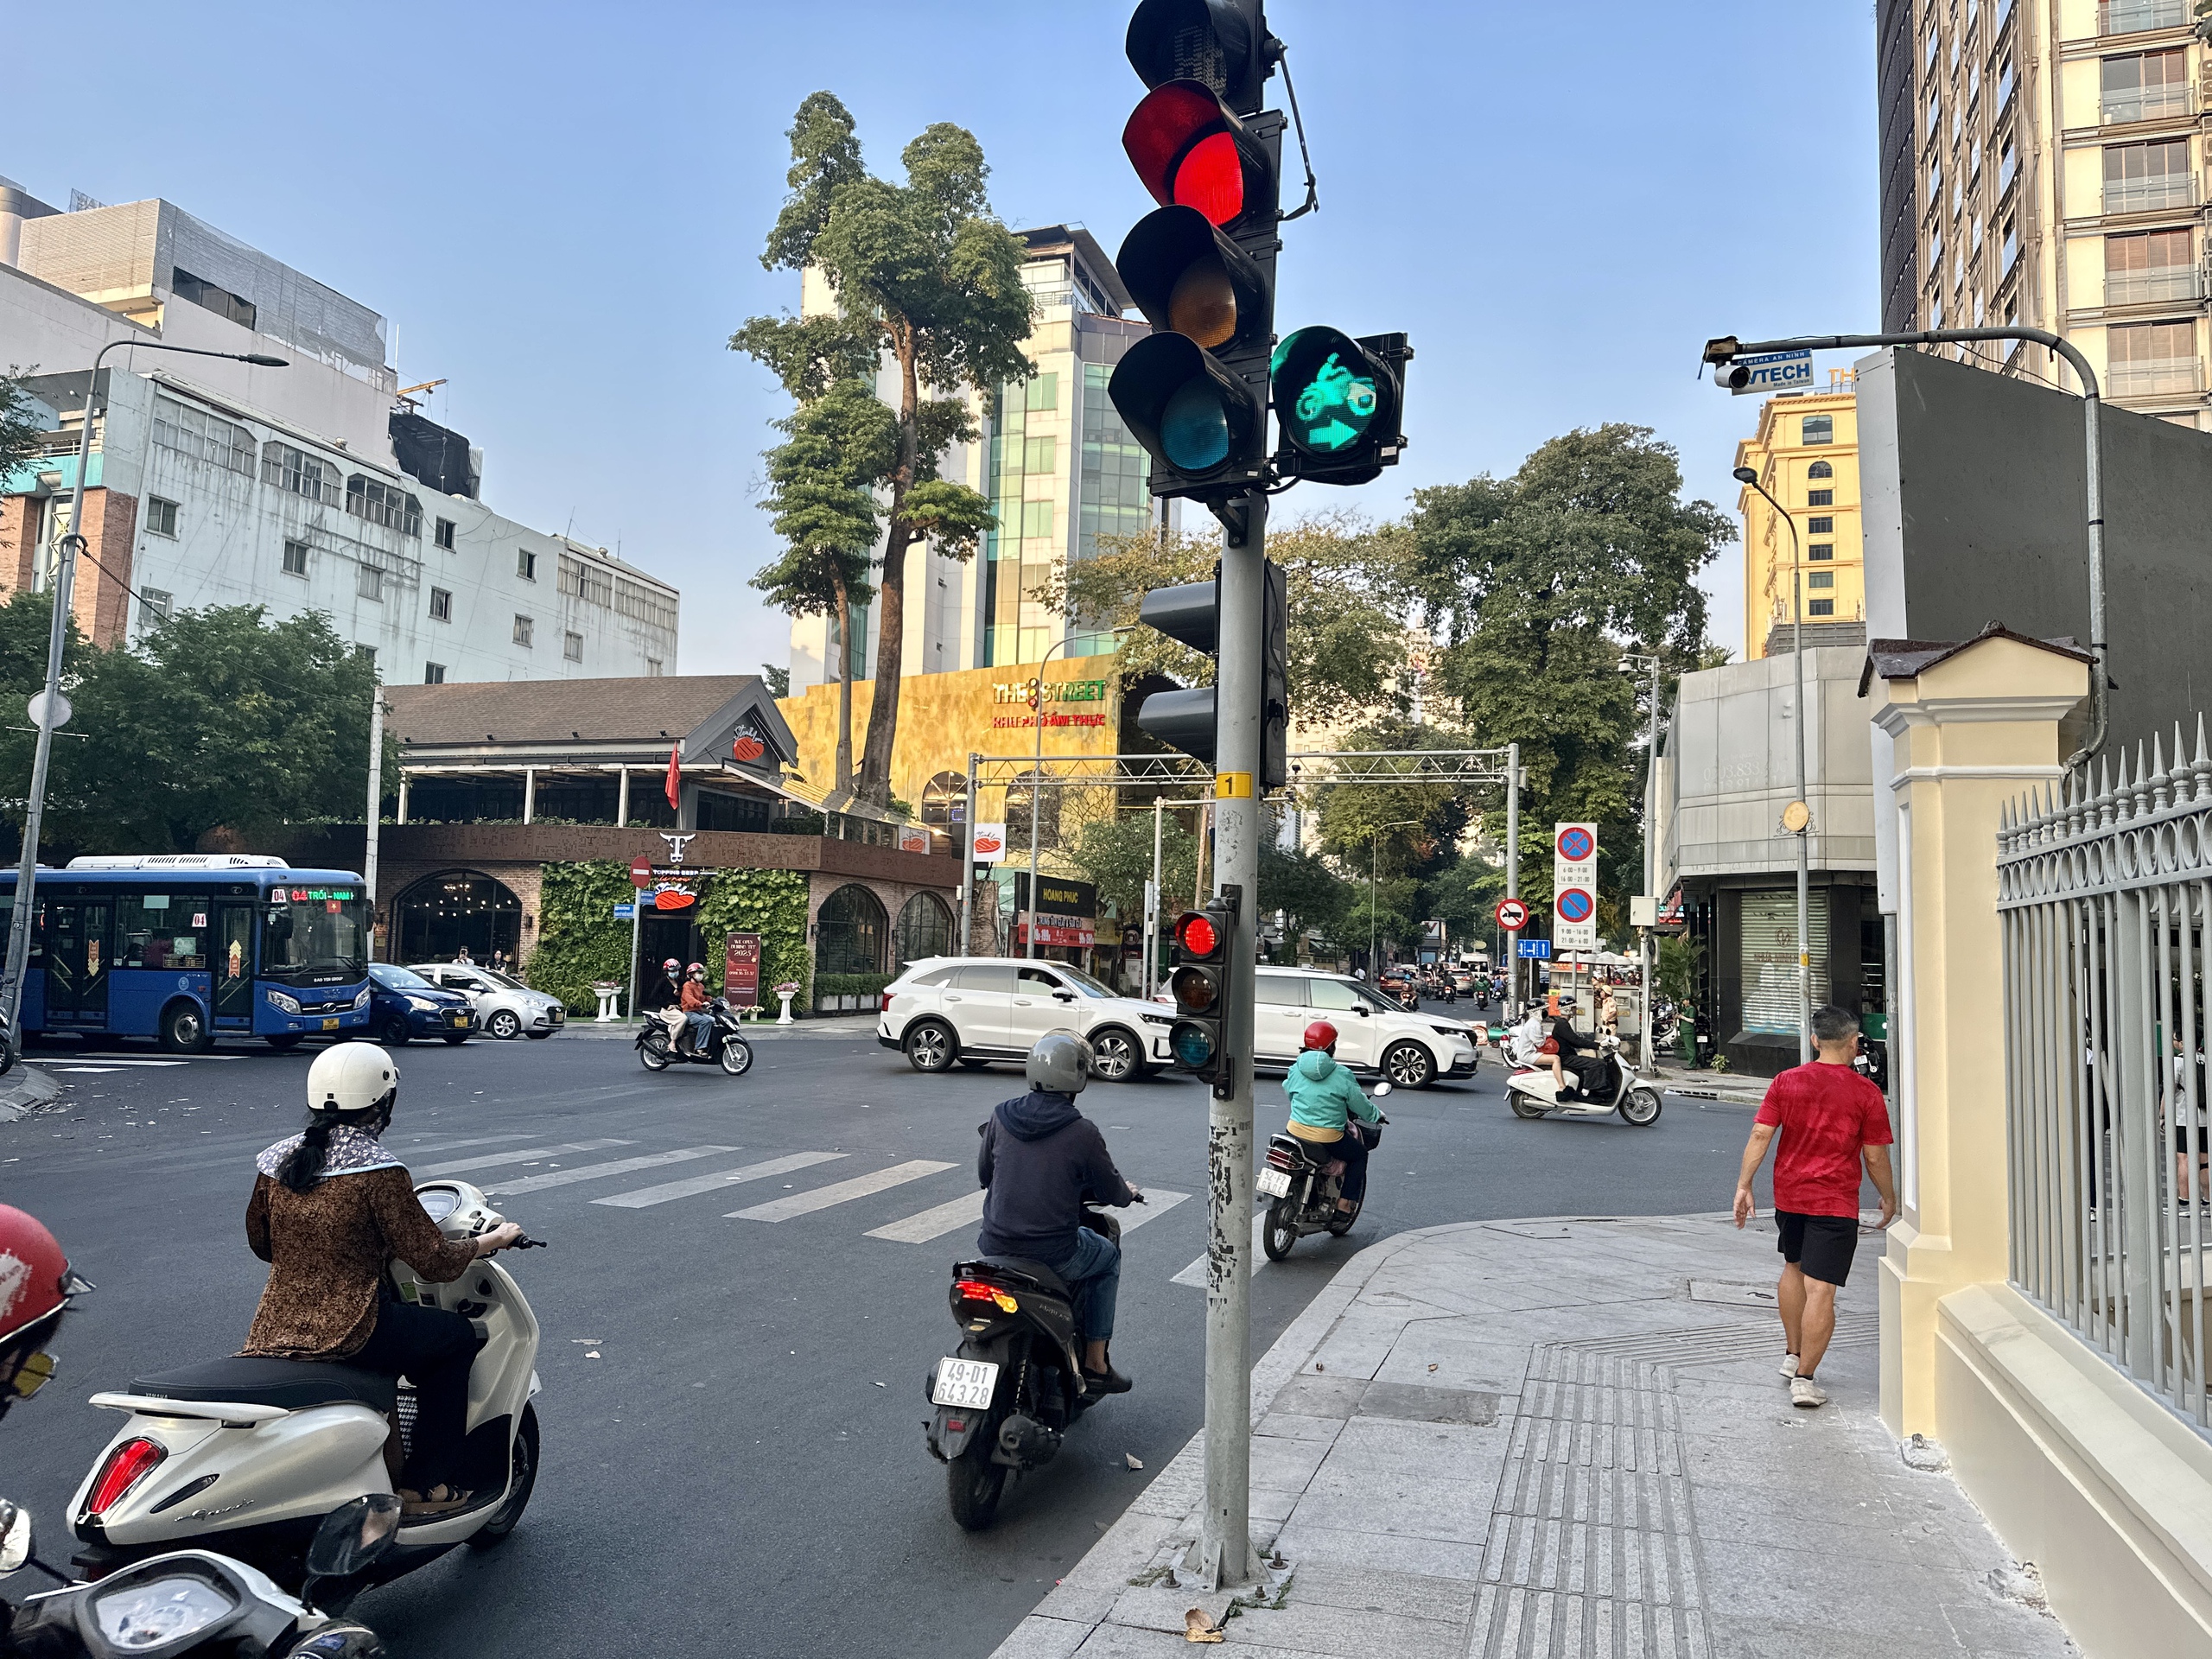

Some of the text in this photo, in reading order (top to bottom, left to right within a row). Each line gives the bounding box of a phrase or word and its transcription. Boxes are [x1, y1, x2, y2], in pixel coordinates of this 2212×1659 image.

[1748, 363, 1810, 385] VTECH
[993, 679, 1106, 704] THE STREET
[1225, 776, 1233, 795] 1
[274, 890, 285, 901] 04
[291, 890, 308, 901] 04
[194, 914, 206, 925] 04
[938, 1382, 989, 1405] 643.28
